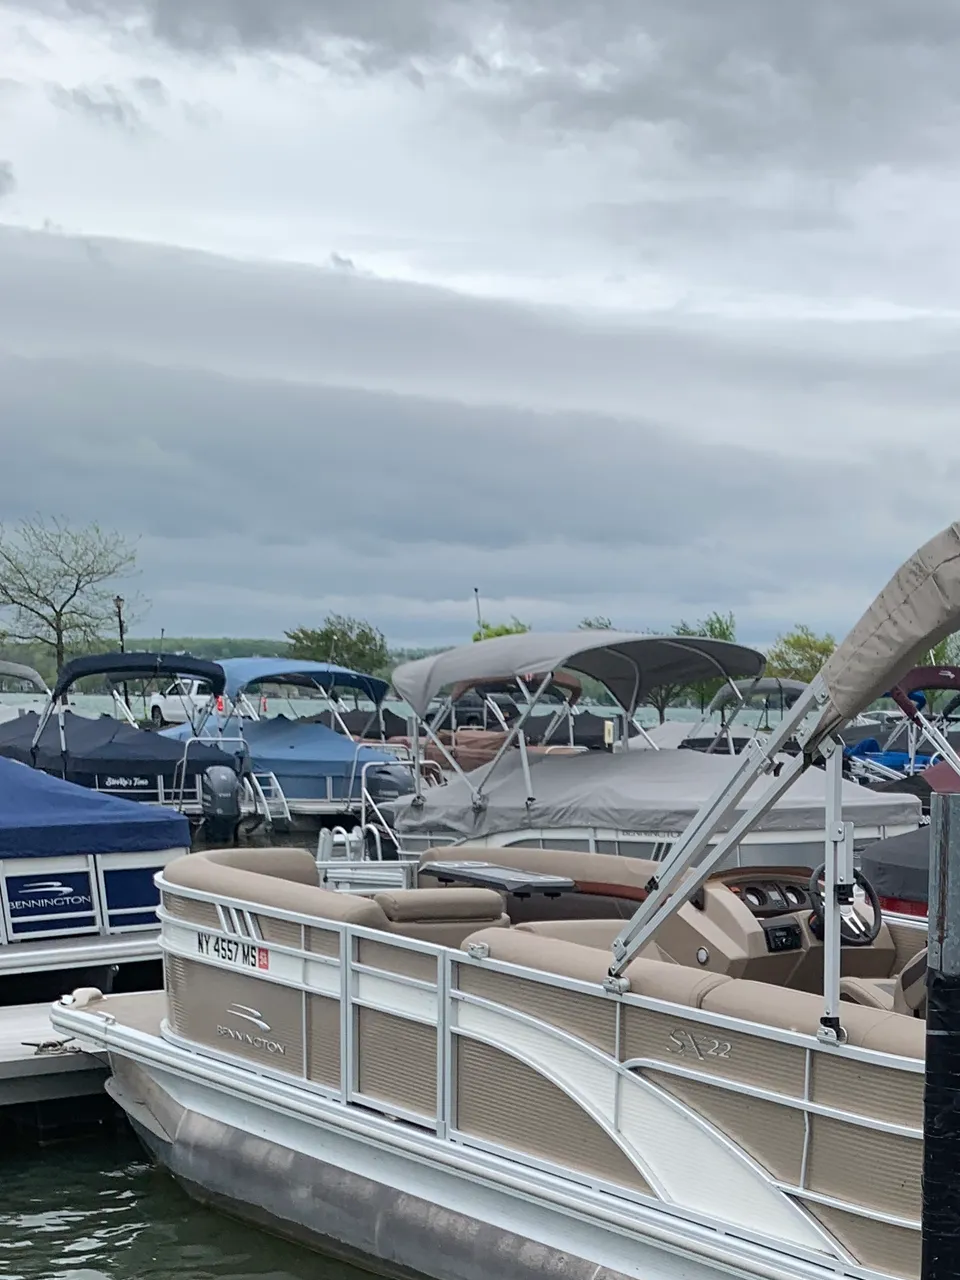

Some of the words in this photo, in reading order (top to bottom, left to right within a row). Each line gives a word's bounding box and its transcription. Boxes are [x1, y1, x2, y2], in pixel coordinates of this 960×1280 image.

[9, 895, 92, 910] BENNINGTON
[198, 932, 210, 955] NY
[214, 937, 239, 963] 4557
[242, 943, 257, 968] MS
[216, 1024, 286, 1056] BENNINGTON
